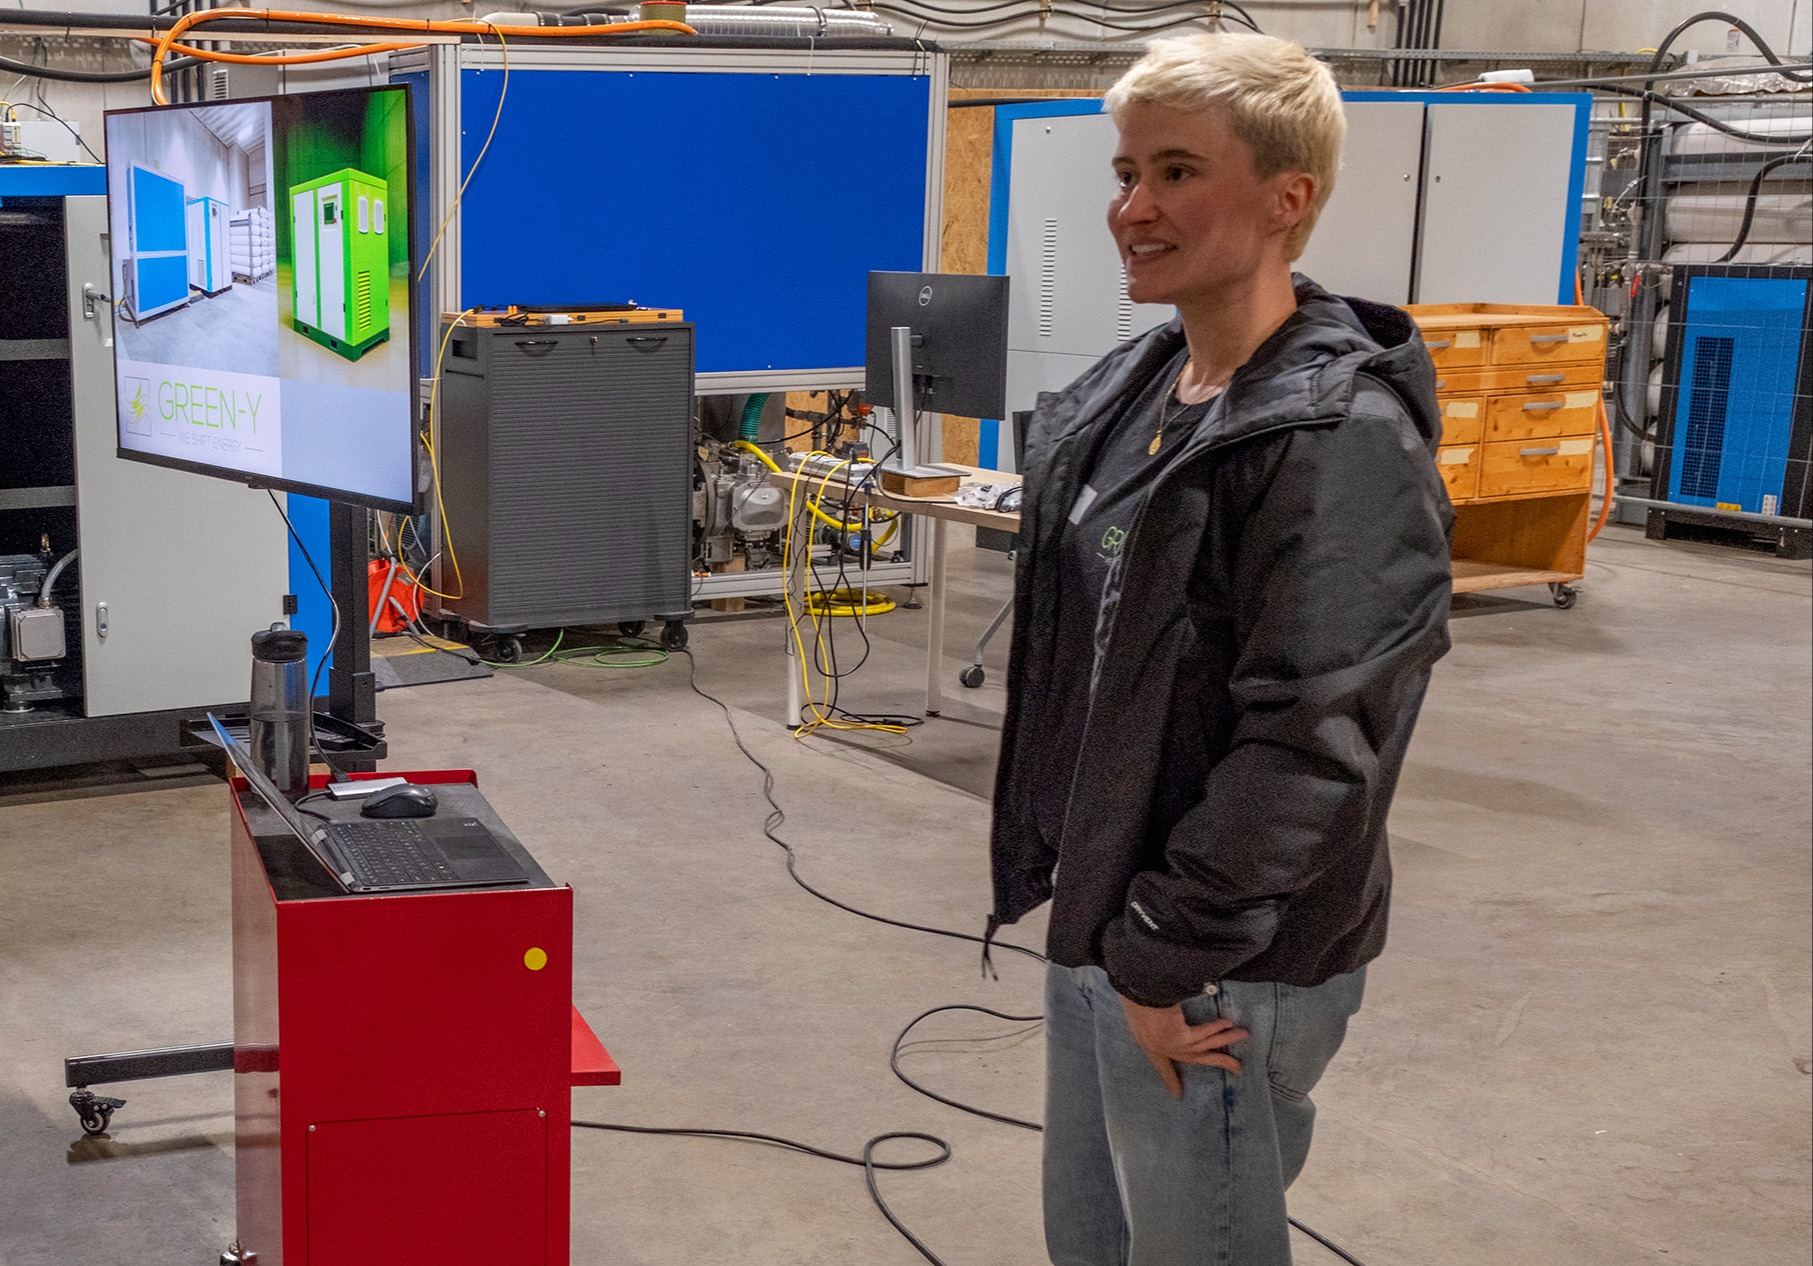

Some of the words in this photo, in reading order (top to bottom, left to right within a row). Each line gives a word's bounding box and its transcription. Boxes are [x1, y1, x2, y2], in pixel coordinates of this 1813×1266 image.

[158, 381, 262, 433] GREEN-Y
[178, 431, 191, 445] WE
[191, 432, 211, 448] SHIFT
[212, 436, 241, 453] ENERGY
